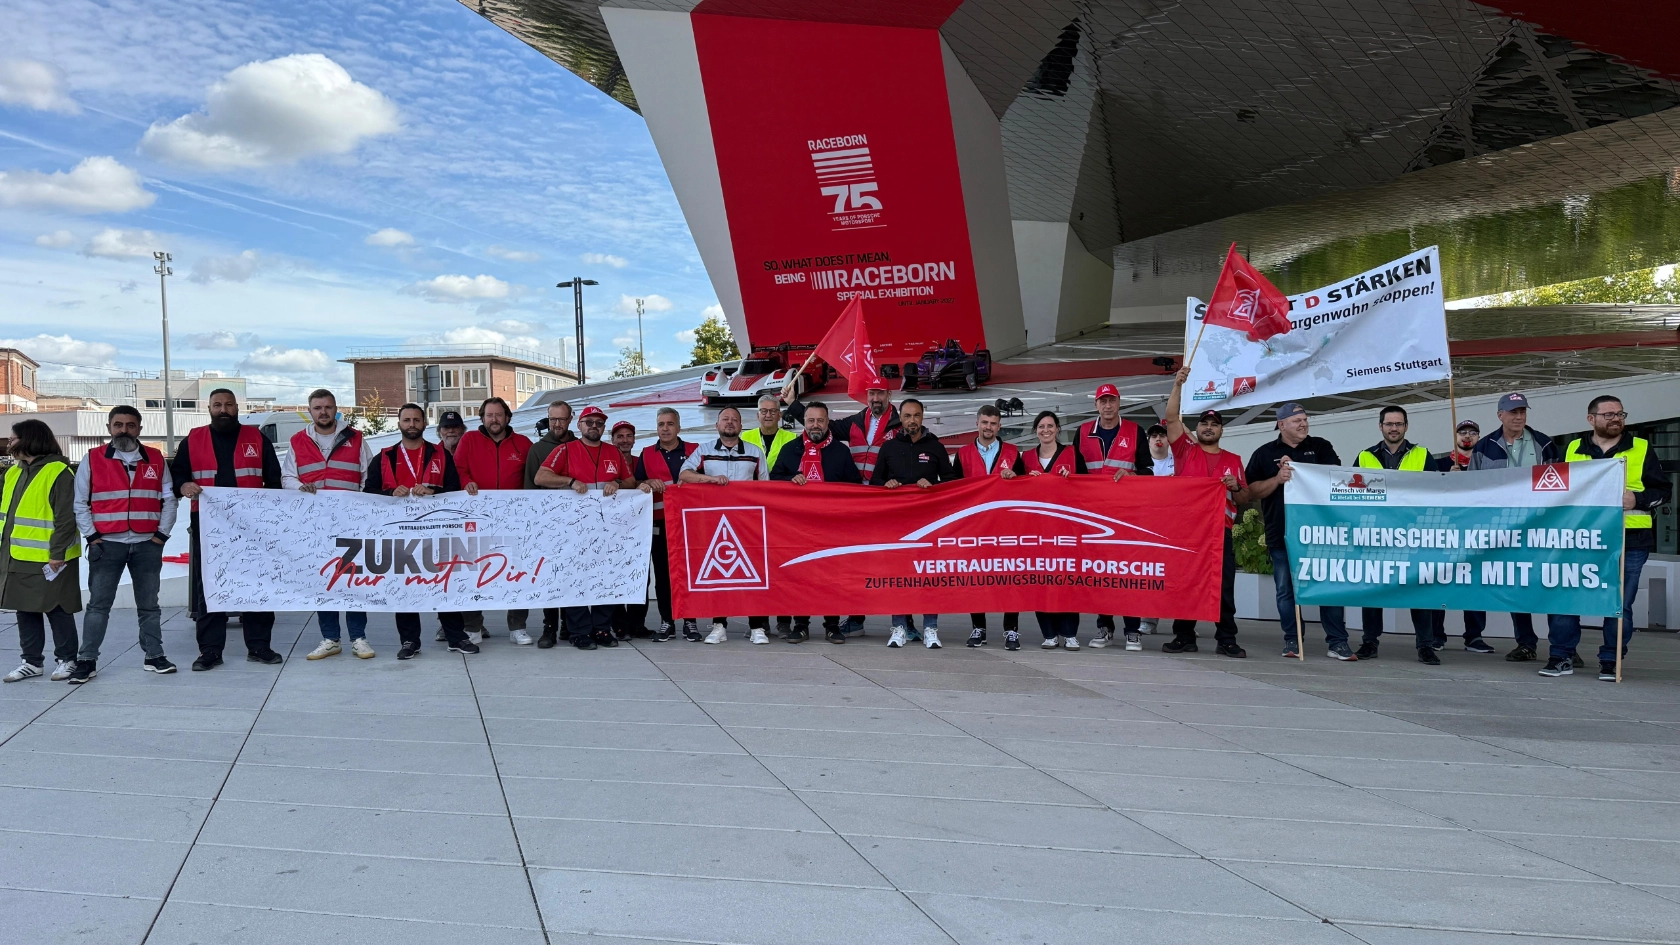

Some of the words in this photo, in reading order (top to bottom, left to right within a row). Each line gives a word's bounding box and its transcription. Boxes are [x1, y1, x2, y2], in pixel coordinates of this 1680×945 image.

[807, 133, 868, 151] RACEBORN
[820, 181, 883, 213] 75
[763, 260, 780, 271] SO,
[781, 257, 813, 270] WHAT
[815, 255, 844, 267] DOES
[845, 254, 855, 265] IT
[857, 252, 892, 264] MEAN,
[774, 272, 806, 284] BEING
[833, 260, 956, 288] RACEBORN
[1304, 295, 1321, 310] D
[1327, 255, 1431, 304] STÄRKEN
[836, 289, 877, 301] SPECIAL
[878, 285, 934, 298] EXHIBITION
[1290, 302, 1369, 331] argenwahn
[1372, 281, 1435, 307] stoppen!
[1346, 365, 1392, 378] Siemens
[1394, 357, 1443, 372] Stuttgart
[1366, 487, 1386, 495] Marge
[937, 535, 1077, 548] PORSCHE
[1299, 525, 1349, 546] OHNE
[1353, 526, 1460, 549] MENSCHEN
[1464, 529, 1522, 550] KEINE
[1526, 528, 1608, 550] MARGE.
[319, 556, 385, 592] Nur
[405, 554, 473, 593] mit
[474, 553, 545, 588] Dir!
[913, 557, 1076, 574] VERTRAUENSLEUTE
[1081, 559, 1165, 577] PORSCHE
[1298, 557, 1411, 585] ZUKUNFT
[1418, 562, 1472, 585] NUR
[1481, 561, 1533, 587] MIT
[1541, 563, 1608, 589] UNS.
